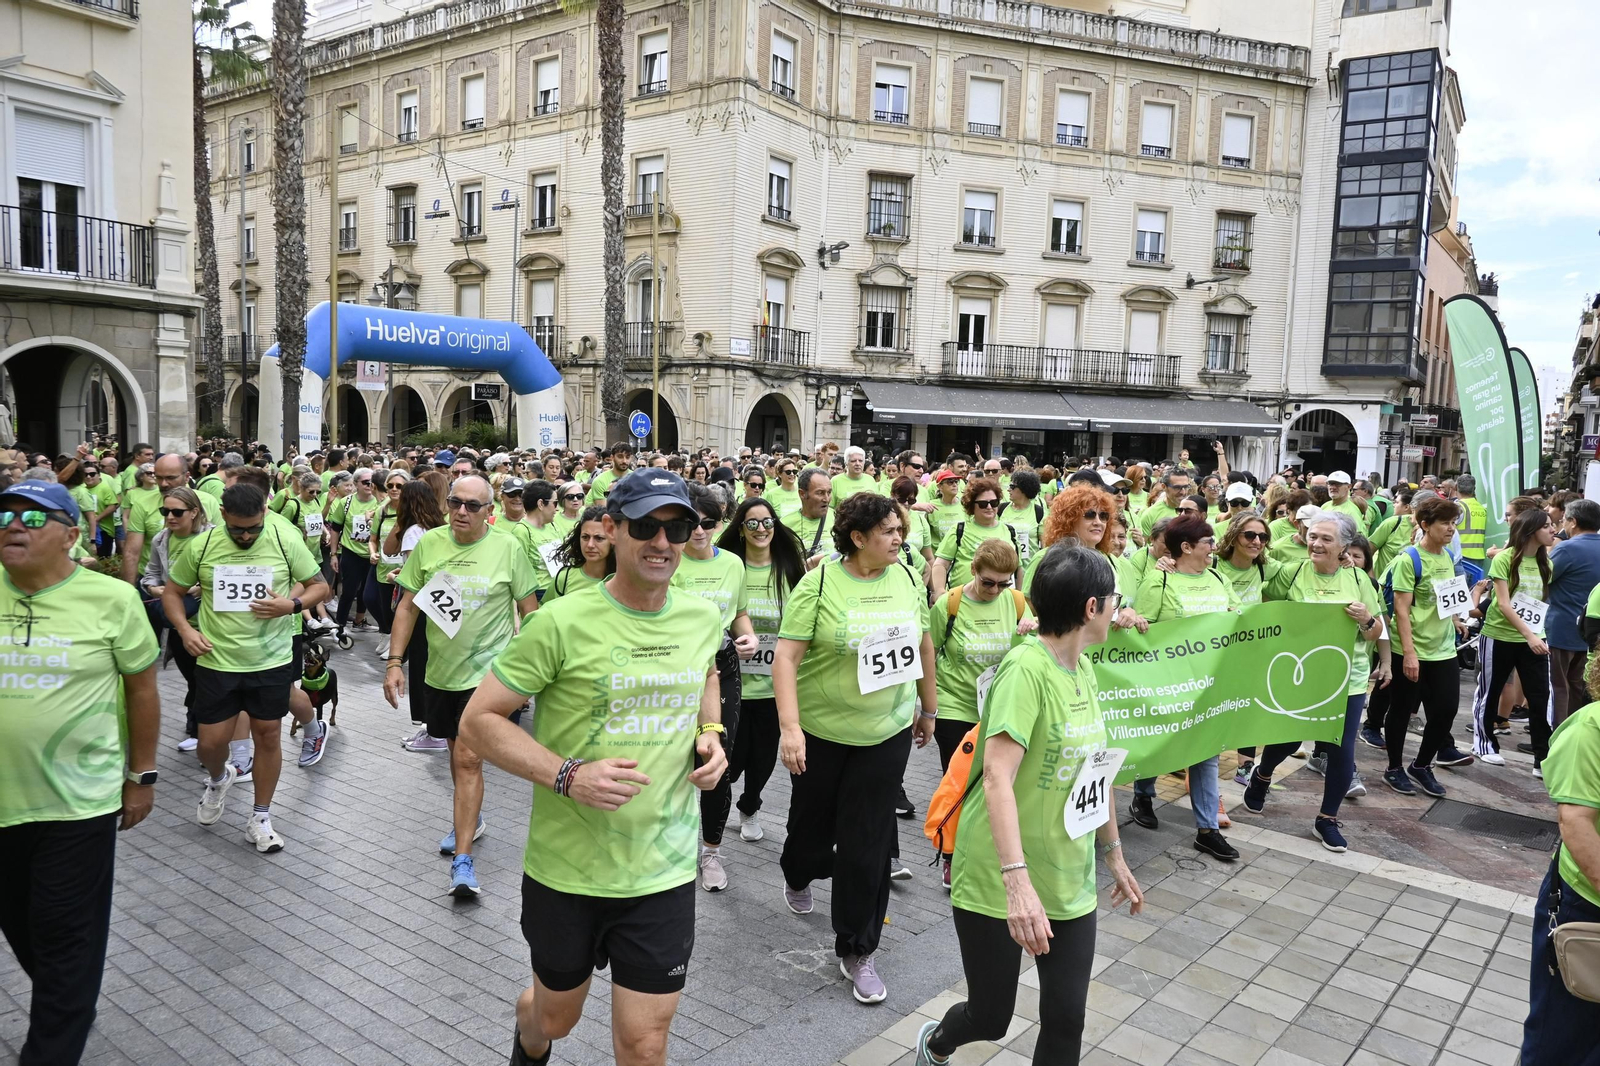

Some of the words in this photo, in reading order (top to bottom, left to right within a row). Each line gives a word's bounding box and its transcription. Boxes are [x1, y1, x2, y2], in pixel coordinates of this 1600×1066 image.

[366, 317, 440, 346] Huelva
[446, 330, 510, 354] original
[300, 403, 320, 414] elva
[430, 590, 461, 622] 424
[748, 608, 771, 617] ntra
[848, 610, 865, 619] En
[869, 610, 914, 619] marcha
[835, 610, 848, 656] HUELVA
[1092, 647, 1104, 664] el
[1108, 647, 1160, 664] Cáncer
[1165, 639, 1206, 659] solo
[1210, 629, 1255, 649] somos
[1257, 624, 1281, 640] uno
[0, 650, 41, 667] ntra
[46, 651, 69, 668] el
[965, 642, 1003, 651] contra
[966, 652, 1002, 663] cánc
[2, 673, 69, 689] ncer
[611, 672, 635, 690] En
[641, 666, 703, 687] marcha
[1097, 685, 1154, 702] ociación
[1156, 675, 1215, 697] española
[586, 674, 608, 746] HUELVA
[610, 692, 682, 713] contra
[684, 687, 702, 707] el
[1102, 707, 1129, 722] ntra
[1133, 704, 1146, 717] el
[1150, 700, 1195, 716] cáncer
[605, 708, 697, 735] cáncer
[1108, 721, 1179, 740] Villanueva
[1181, 716, 1193, 730] de
[1194, 713, 1205, 726] los
[1206, 697, 1250, 719] Castillejos
[1037, 722, 1062, 790] HUELVA
